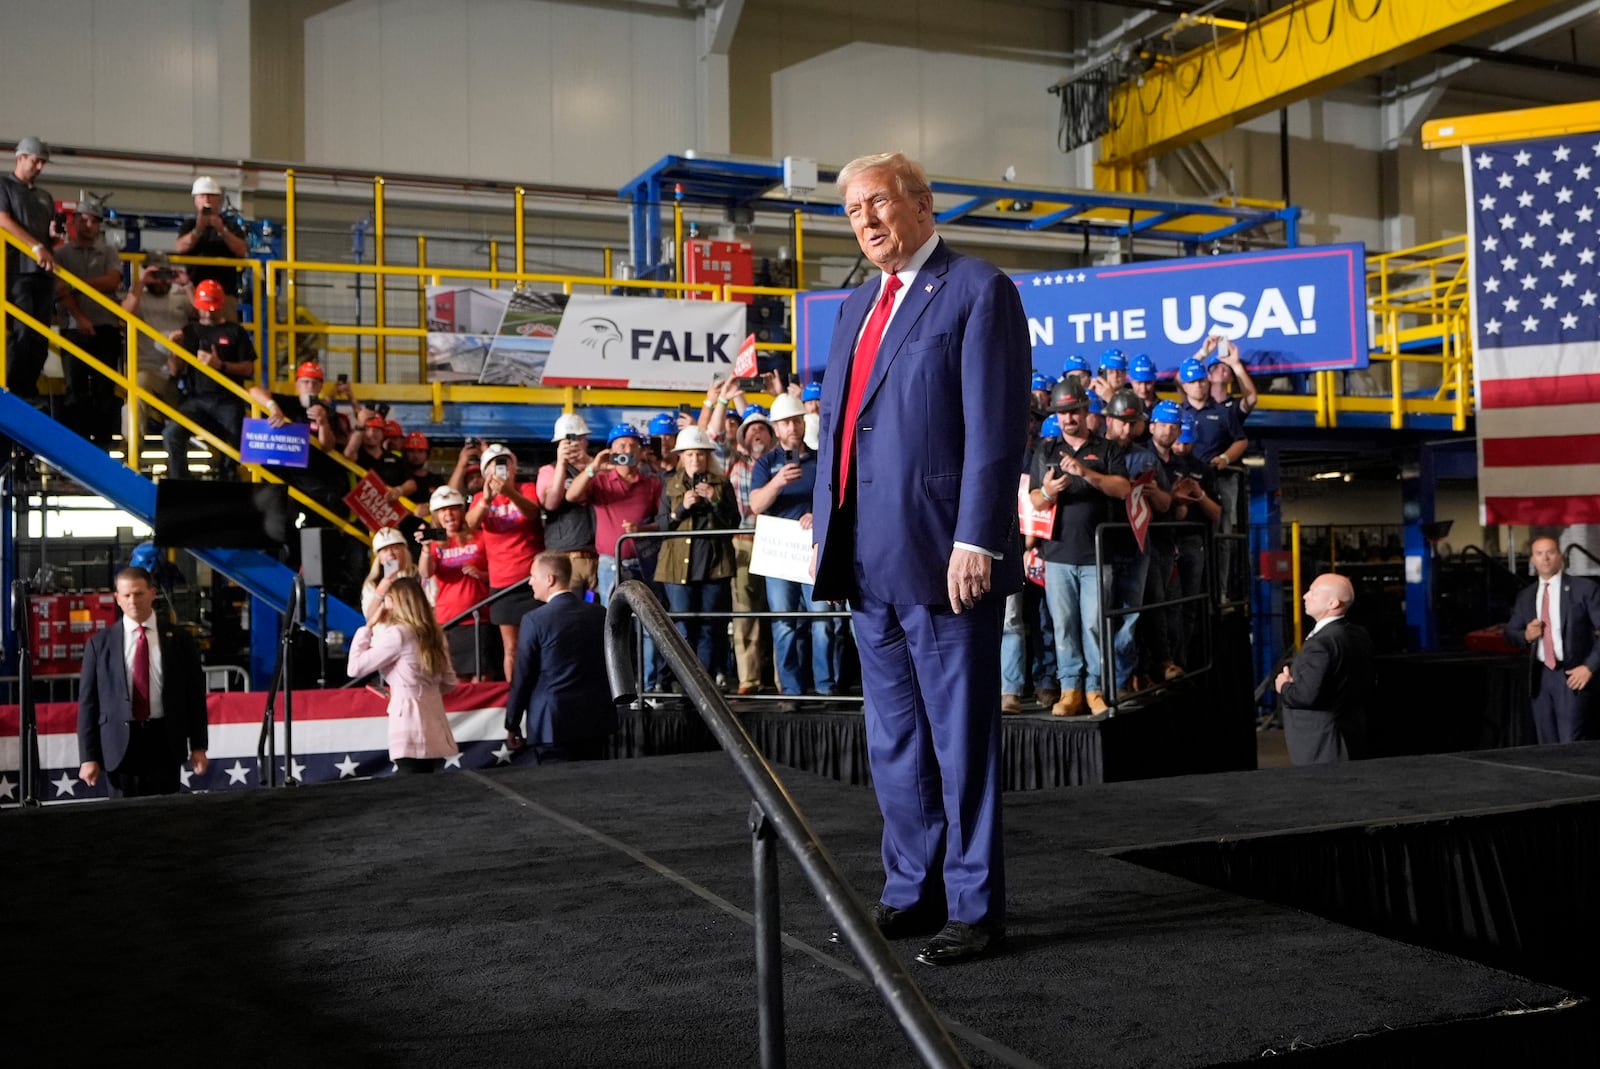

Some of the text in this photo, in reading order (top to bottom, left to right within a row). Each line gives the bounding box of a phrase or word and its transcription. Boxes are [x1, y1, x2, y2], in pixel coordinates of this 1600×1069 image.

[1027, 285, 1317, 347] N THE USA!
[631, 329, 732, 364] FALK
[246, 432, 306, 445] MAKE AMERICA
[248, 441, 302, 452] GREAT AGAIN
[360, 491, 390, 525] VANCE
[361, 480, 400, 521] TRUMP
